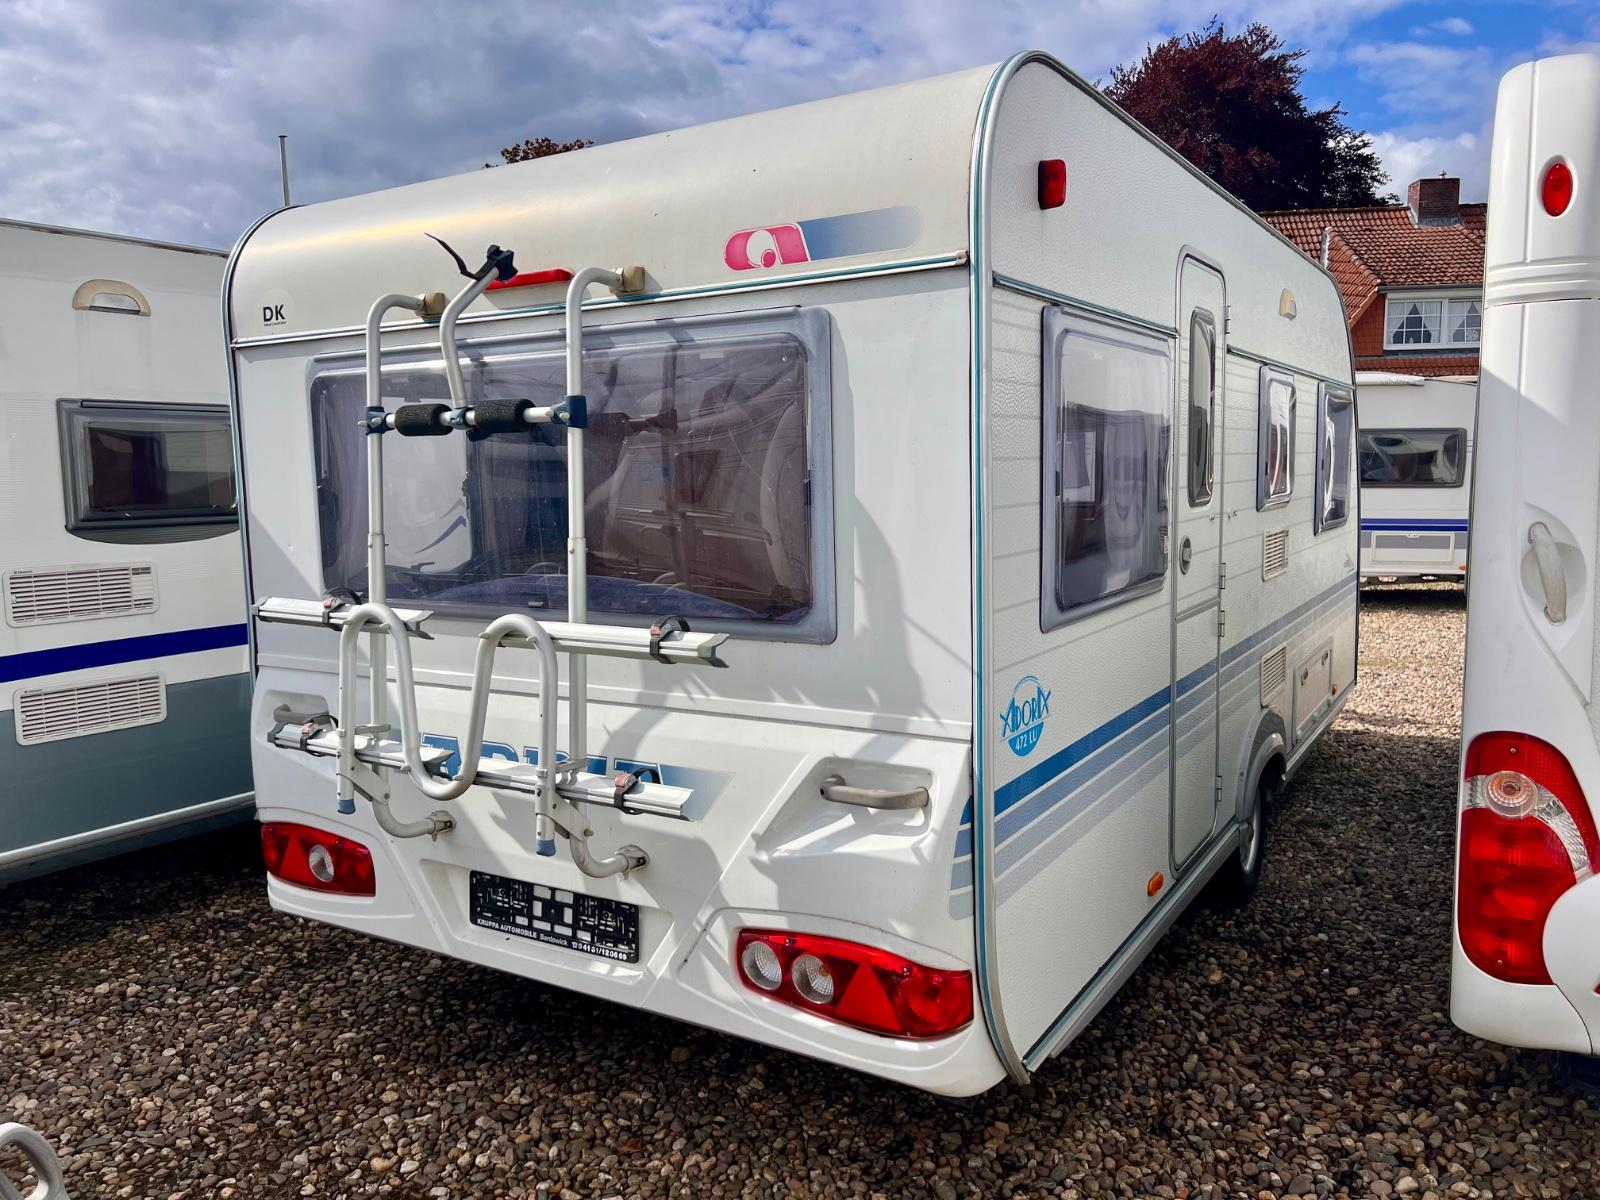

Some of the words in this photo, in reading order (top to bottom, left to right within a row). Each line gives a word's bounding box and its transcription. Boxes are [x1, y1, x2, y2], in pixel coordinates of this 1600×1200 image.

[263, 304, 286, 322] DK
[1029, 728, 1038, 744] LU
[477, 918, 500, 930] KRUPPA
[500, 923, 538, 939] AUTOMOBILE
[539, 933, 568, 946] Bardowick
